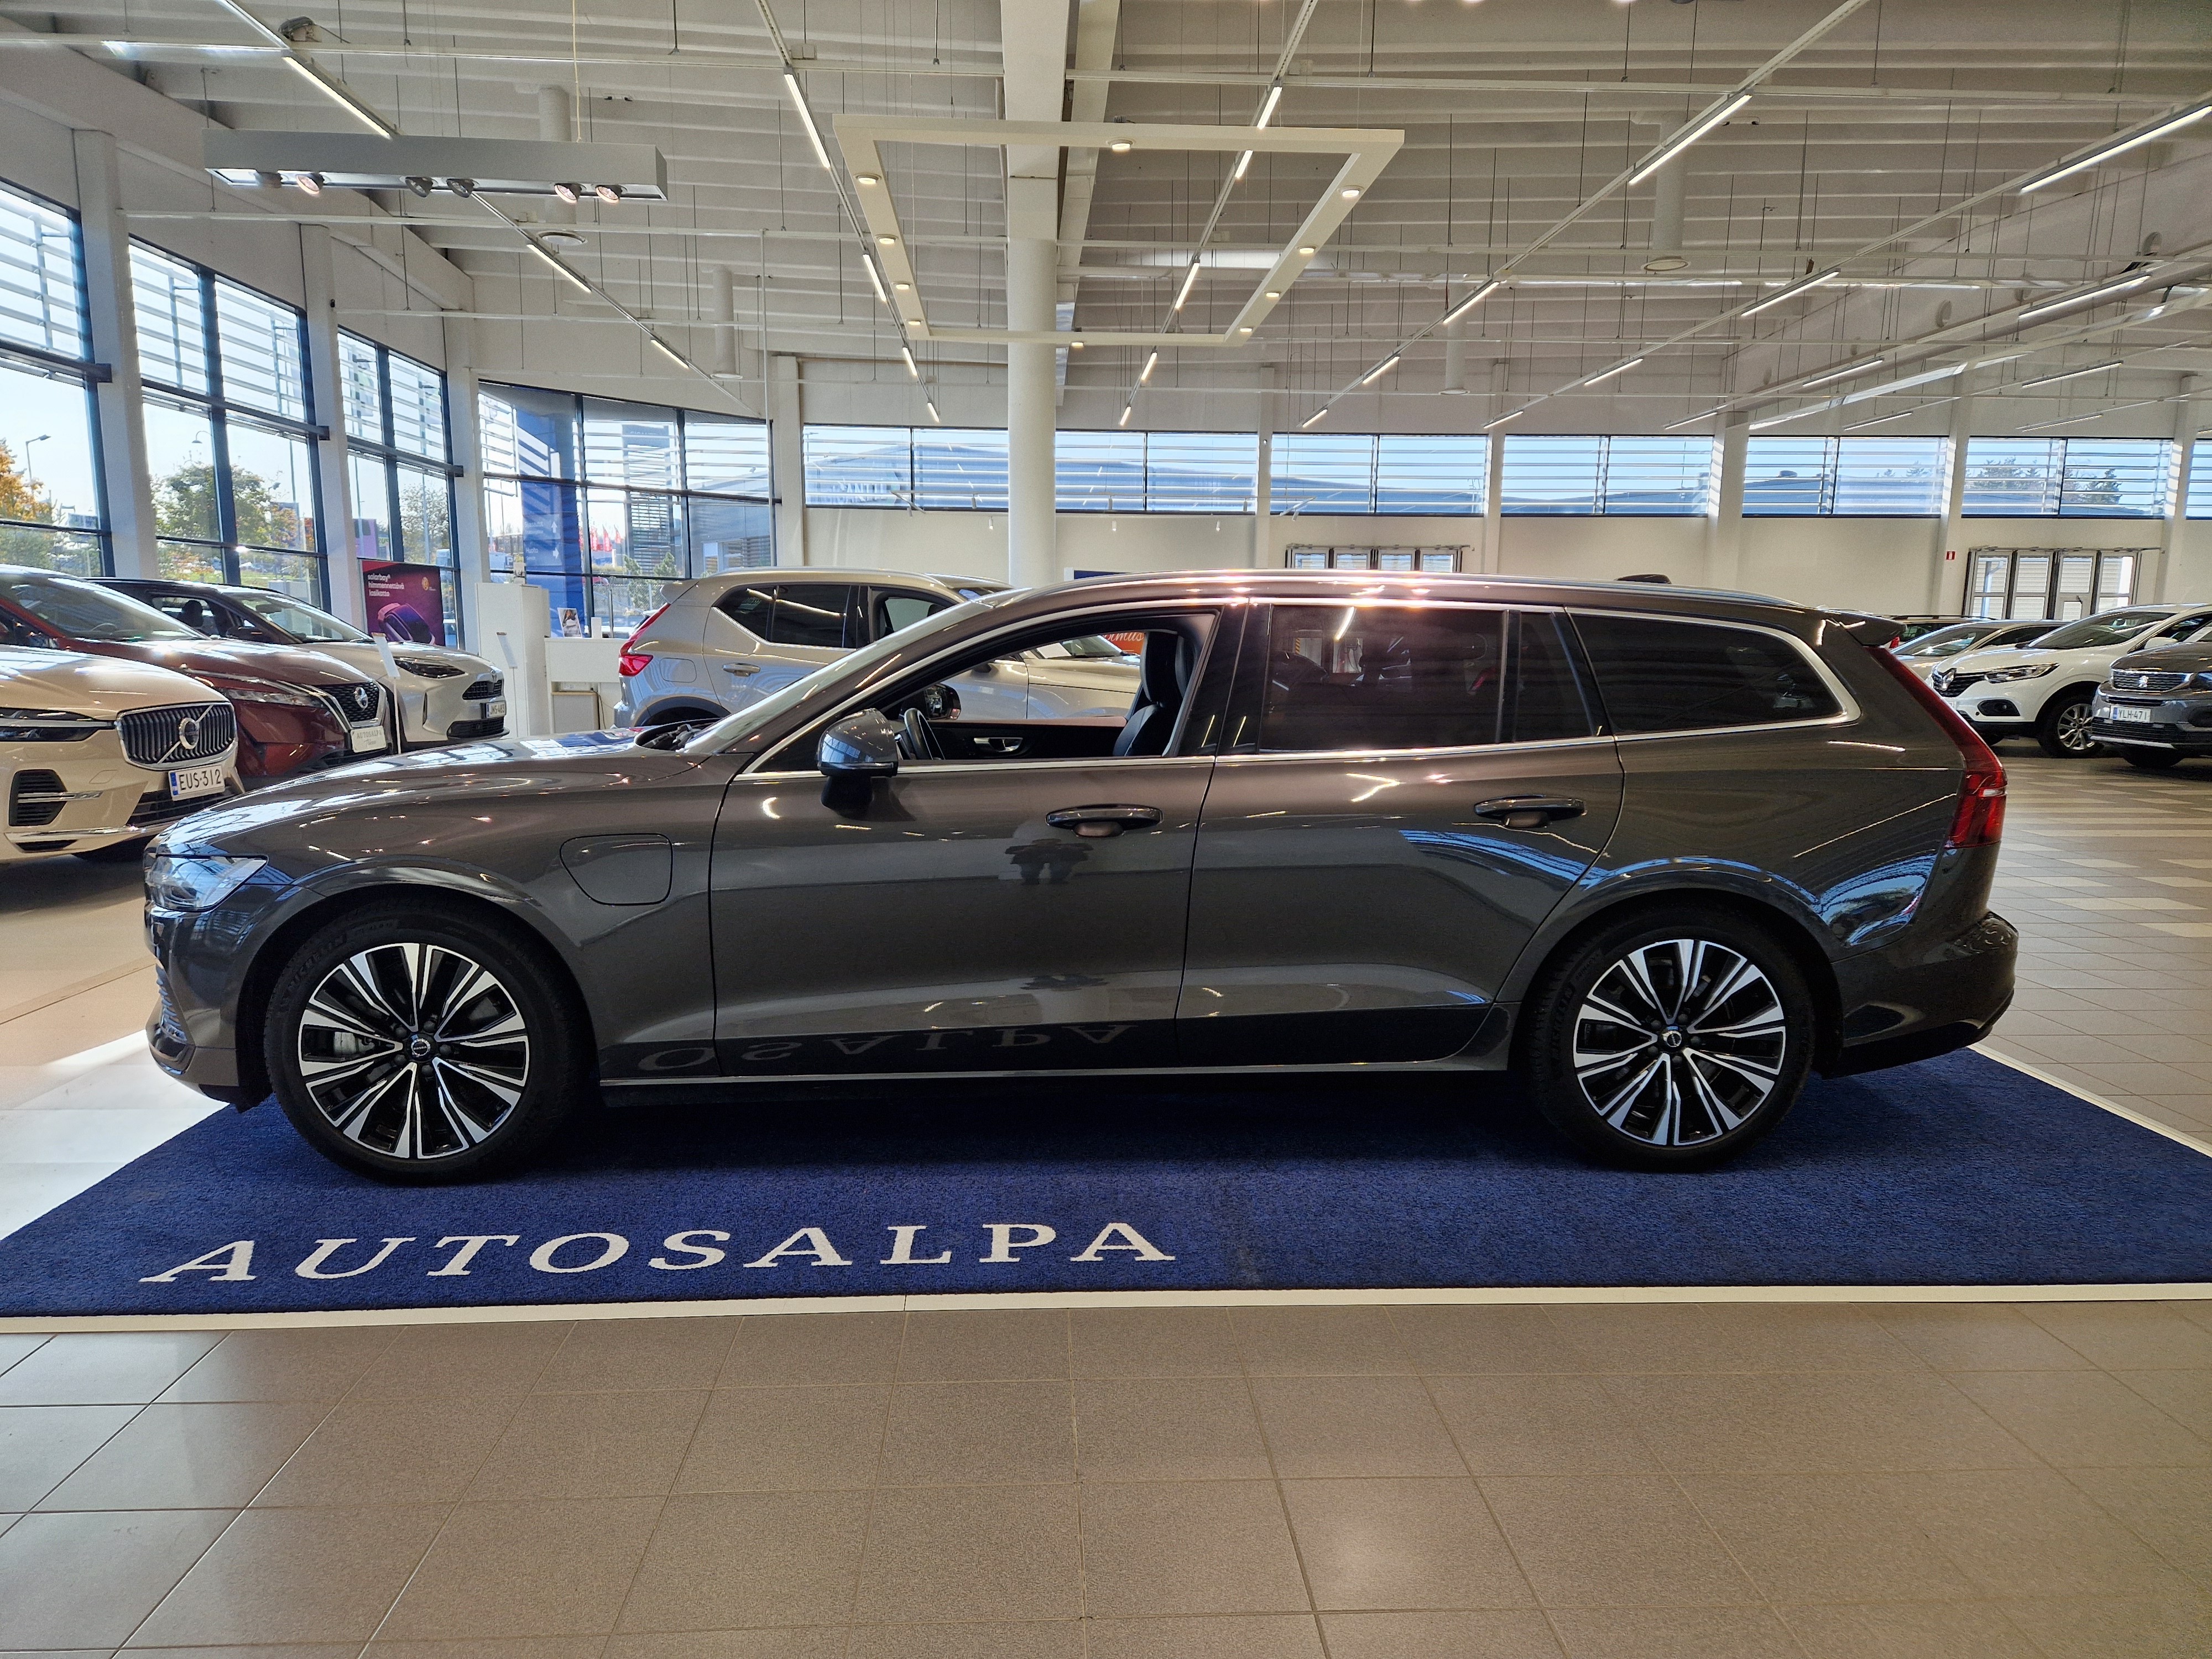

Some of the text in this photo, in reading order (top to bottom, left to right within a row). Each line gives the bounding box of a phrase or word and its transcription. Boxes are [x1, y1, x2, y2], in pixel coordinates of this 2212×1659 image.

[368, 581, 405, 589] himmennettävä
[2119, 709, 2147, 720] YLH-471
[357, 729, 382, 739] AUTOSALPA
[179, 769, 221, 791] EUS-312
[138, 1223, 1175, 1282] AUTOSALPA
